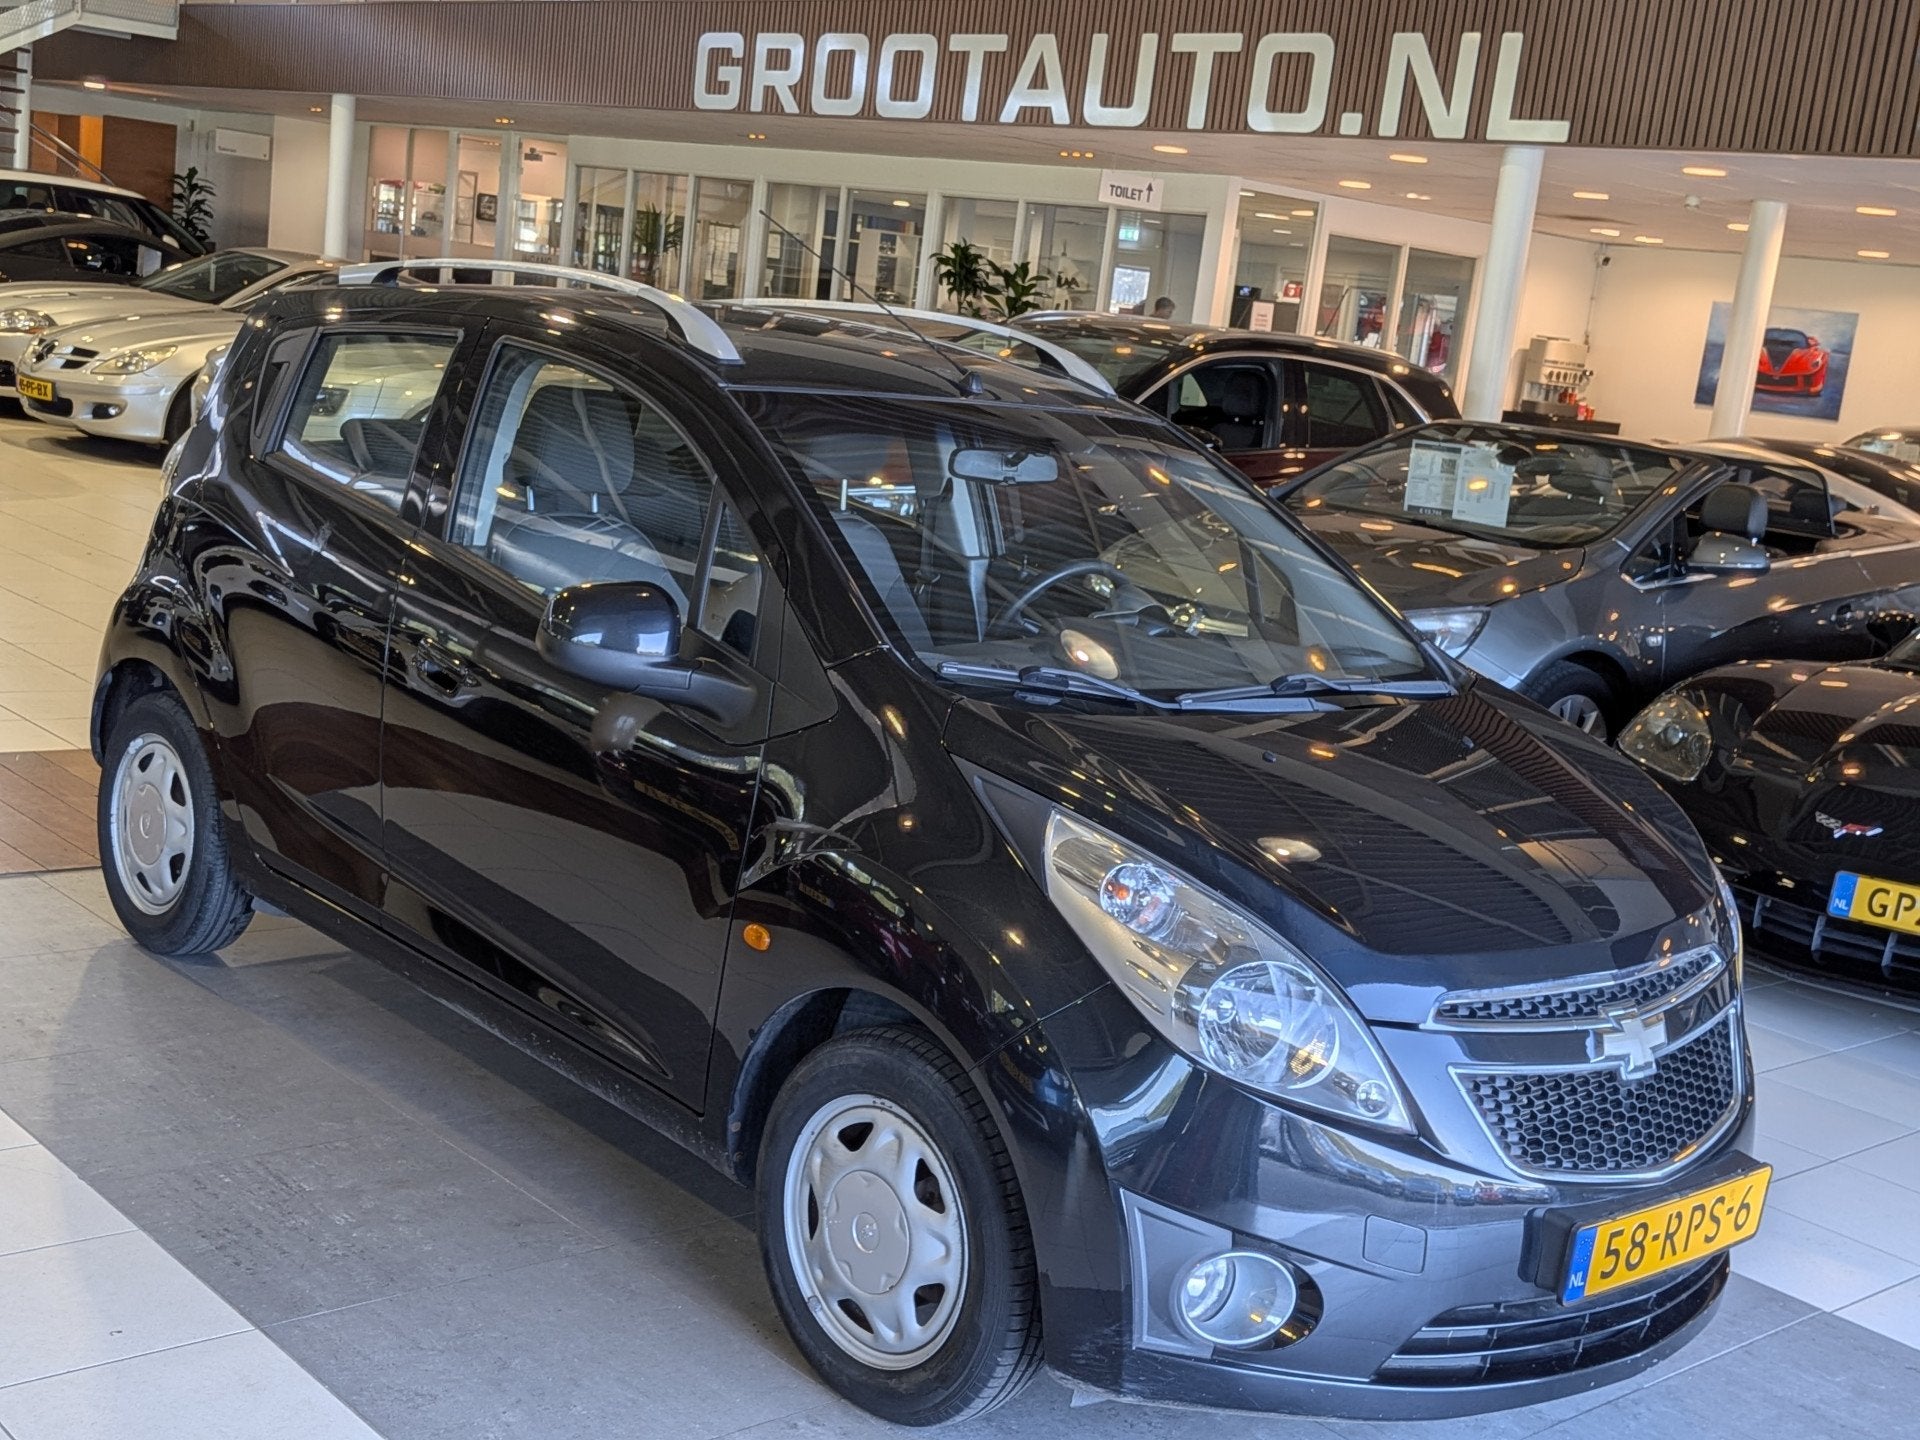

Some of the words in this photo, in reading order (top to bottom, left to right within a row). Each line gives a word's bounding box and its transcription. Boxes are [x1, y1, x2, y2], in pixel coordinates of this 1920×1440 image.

[692, 31, 1571, 143] GROOTAUTO.NL
[1109, 184, 1143, 201] TOILET
[1833, 898, 1849, 911] NL
[1867, 887, 1920, 926] GP
[1600, 1184, 1754, 1280] 58-RPS-6
[1568, 1273, 1585, 1289] NL
